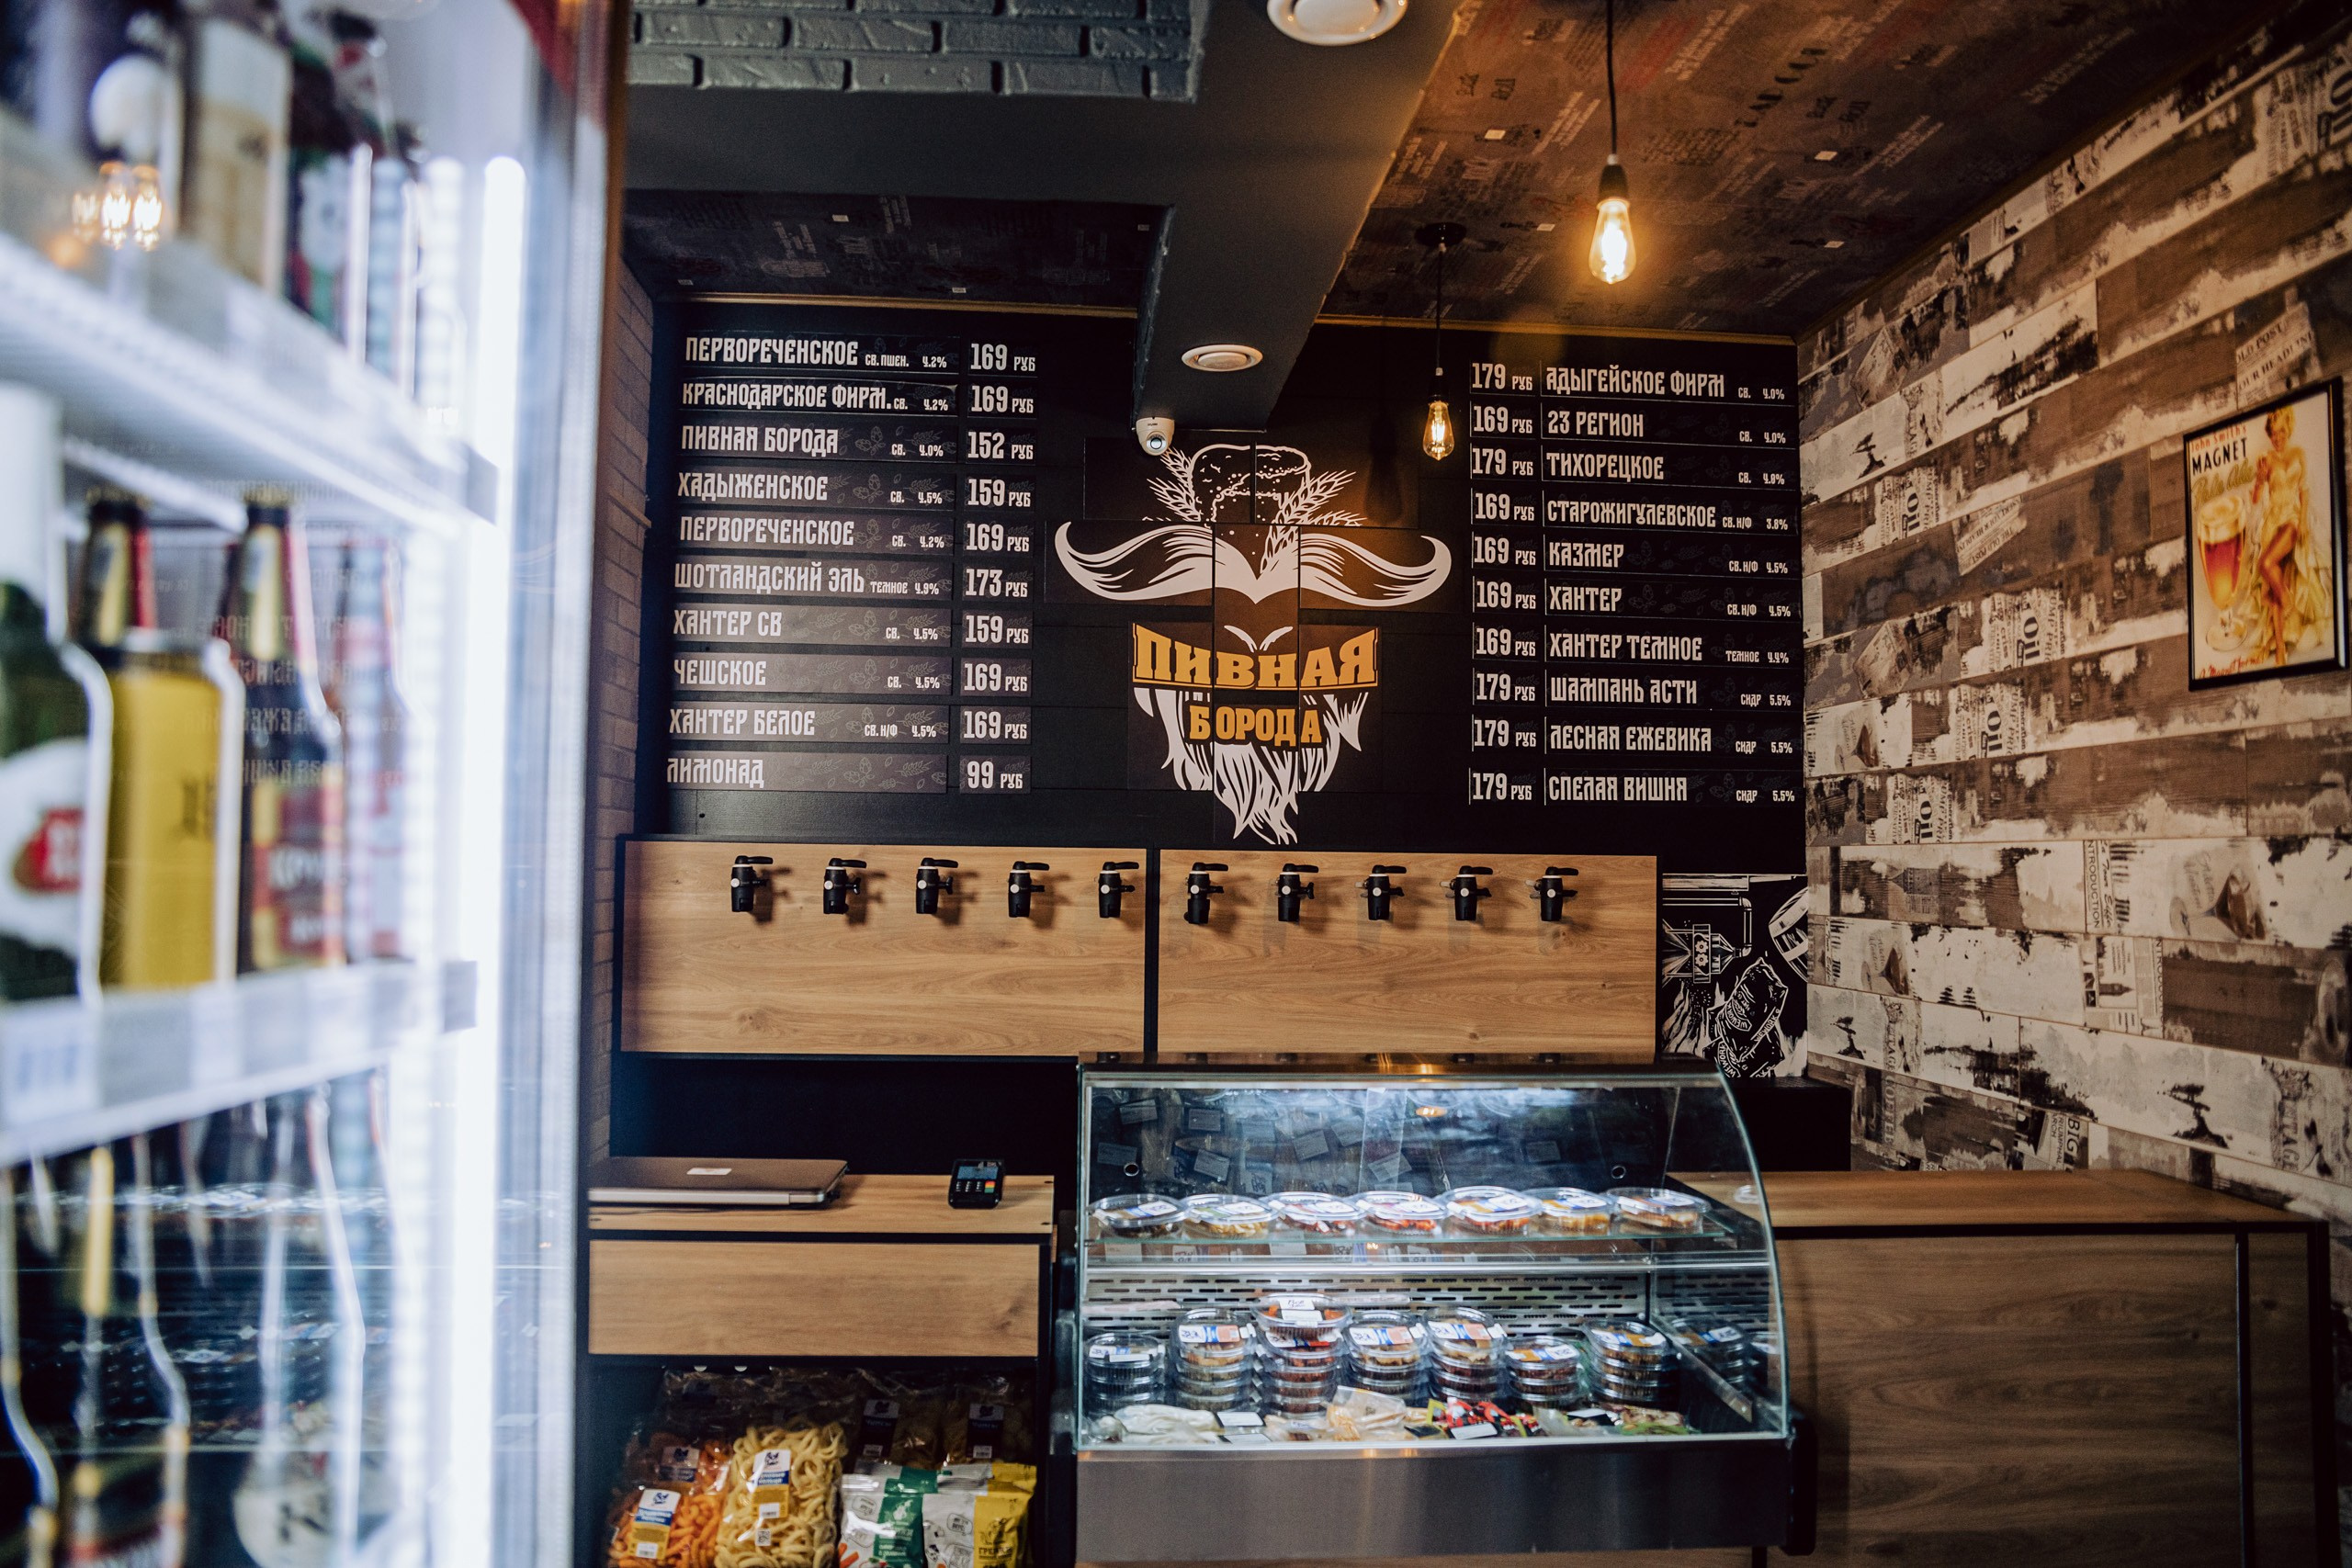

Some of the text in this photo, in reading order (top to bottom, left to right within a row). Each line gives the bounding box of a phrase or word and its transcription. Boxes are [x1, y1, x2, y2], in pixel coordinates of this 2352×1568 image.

[685, 337, 858, 366] ПЕРВОРЕЧЕНСКОЕ
[922, 356, 947, 368] 4.2%
[970, 344, 1007, 370] 169
[1014, 356, 1035, 372] РУБ
[683, 383, 827, 411] КРАСНОДАРСКОЕ
[831, 386, 891, 410] ФИРМ.
[923, 399, 948, 412] 4.2%
[971, 386, 1007, 412] 169
[1012, 398, 1034, 413] РУБ
[1472, 363, 1506, 389] 179
[1512, 376, 1532, 391] РУБ
[1546, 365, 1665, 395] АДЫГЕЙСКОЕ
[1670, 371, 1724, 397] ФИРМ
[1763, 389, 1785, 400] 4.0%
[682, 425, 758, 451] ПИВНАЯ
[764, 428, 838, 457] БОРОДА
[919, 445, 944, 457] 4.0%
[968, 432, 1004, 458] 152
[1012, 445, 1033, 459] РУБ
[1473, 406, 1509, 433] 169
[1512, 419, 1532, 434] РУБ
[1548, 411, 1569, 434] 23
[1576, 412, 1644, 437] РЕГИОН
[1764, 433, 1786, 445] 4.0%
[1473, 448, 1506, 475] 179
[1512, 461, 1533, 477] РУБ
[1546, 453, 1664, 482] ТИХОРЕЦКОЕ
[2192, 437, 2247, 477] MAGNET
[677, 472, 828, 501] ХАДЫЖЕНСКОЕ
[918, 491, 943, 504] 4.5%
[967, 479, 1005, 506] 159
[1009, 492, 1031, 507] РУБ
[1475, 493, 1510, 520] 169
[1513, 506, 1534, 521] РУБ
[1548, 501, 1715, 527] СТАРОЖИГУЛЕВСКОЕ
[1766, 518, 1788, 530] 3.8%
[1907, 492, 1920, 532] Oil
[680, 516, 854, 546] ПЕРВОРЕЧЕНСКОЕ
[920, 536, 944, 548] 4.2%
[967, 524, 1003, 551] 169
[1007, 536, 1029, 552] РУБ
[1474, 536, 1509, 564] 169
[1515, 551, 1536, 566] РУБ
[1549, 542, 1624, 569] КАЗМЕР
[1767, 562, 1788, 574] 4.5%
[675, 562, 822, 594] ШОТЛАНДСКИЙ
[828, 568, 865, 592] ЭЛЬ
[914, 582, 939, 594] 4.9%
[966, 569, 1002, 596] 173
[1005, 582, 1028, 598] РУБ
[1476, 581, 1512, 608] 169
[1515, 594, 1536, 609] РУБ
[1550, 586, 1623, 612] ХАНТЕР
[1769, 605, 1791, 617] 4.5%
[673, 609, 752, 636] ХАНТЕР
[758, 612, 782, 637] СВ
[966, 615, 1002, 643] 159
[1006, 628, 1029, 644] РУБ
[2024, 617, 2040, 660] Oil
[1132, 623, 1378, 690] ПИВНАЯ
[1476, 628, 1511, 655] 169
[1515, 641, 1536, 656] РУБ
[1550, 633, 1623, 659] ХАНТЕР
[1626, 636, 1702, 661] ТЕМНОЕ
[1768, 652, 1789, 664] 4.4%
[674, 660, 766, 685] ЧЕШСКОЕ
[915, 677, 940, 689] 4.5%
[964, 663, 1001, 692] 169
[1005, 676, 1028, 692] РУБ
[1476, 673, 1511, 701] 179
[1515, 686, 1535, 702] РУБ
[1551, 677, 1644, 703] ШАМПАНЬ
[1650, 680, 1697, 705] АСТИ
[1770, 694, 1791, 706] 5.5%
[669, 708, 747, 734] ХАНТЕР
[753, 710, 815, 736] БЕЛОЕ
[911, 725, 936, 738] 4.5%
[964, 711, 1001, 739] 169
[1005, 724, 1027, 739] РУБ
[1189, 705, 1322, 747] БОРОДА
[1474, 720, 1509, 747] 179
[1516, 732, 1536, 748] РУБ
[1551, 725, 1620, 750] ЛЕСНАЯ
[1626, 726, 1712, 751] ЕЖЕВИКА
[1771, 741, 1792, 753] 5.5%
[1987, 711, 2002, 751] Oil
[667, 758, 1023, 789] ЛИМОНАД 99 РУБ
[1473, 773, 1507, 800] 179
[1511, 785, 1532, 800] РУБ
[1548, 776, 1618, 801] СПЕЛАЯ
[1623, 777, 1687, 801] ВИШНЯ
[1772, 791, 1794, 803] 5.5%
[1920, 801, 1932, 839] Oil
[2066, 1118, 2080, 1153] BIG
